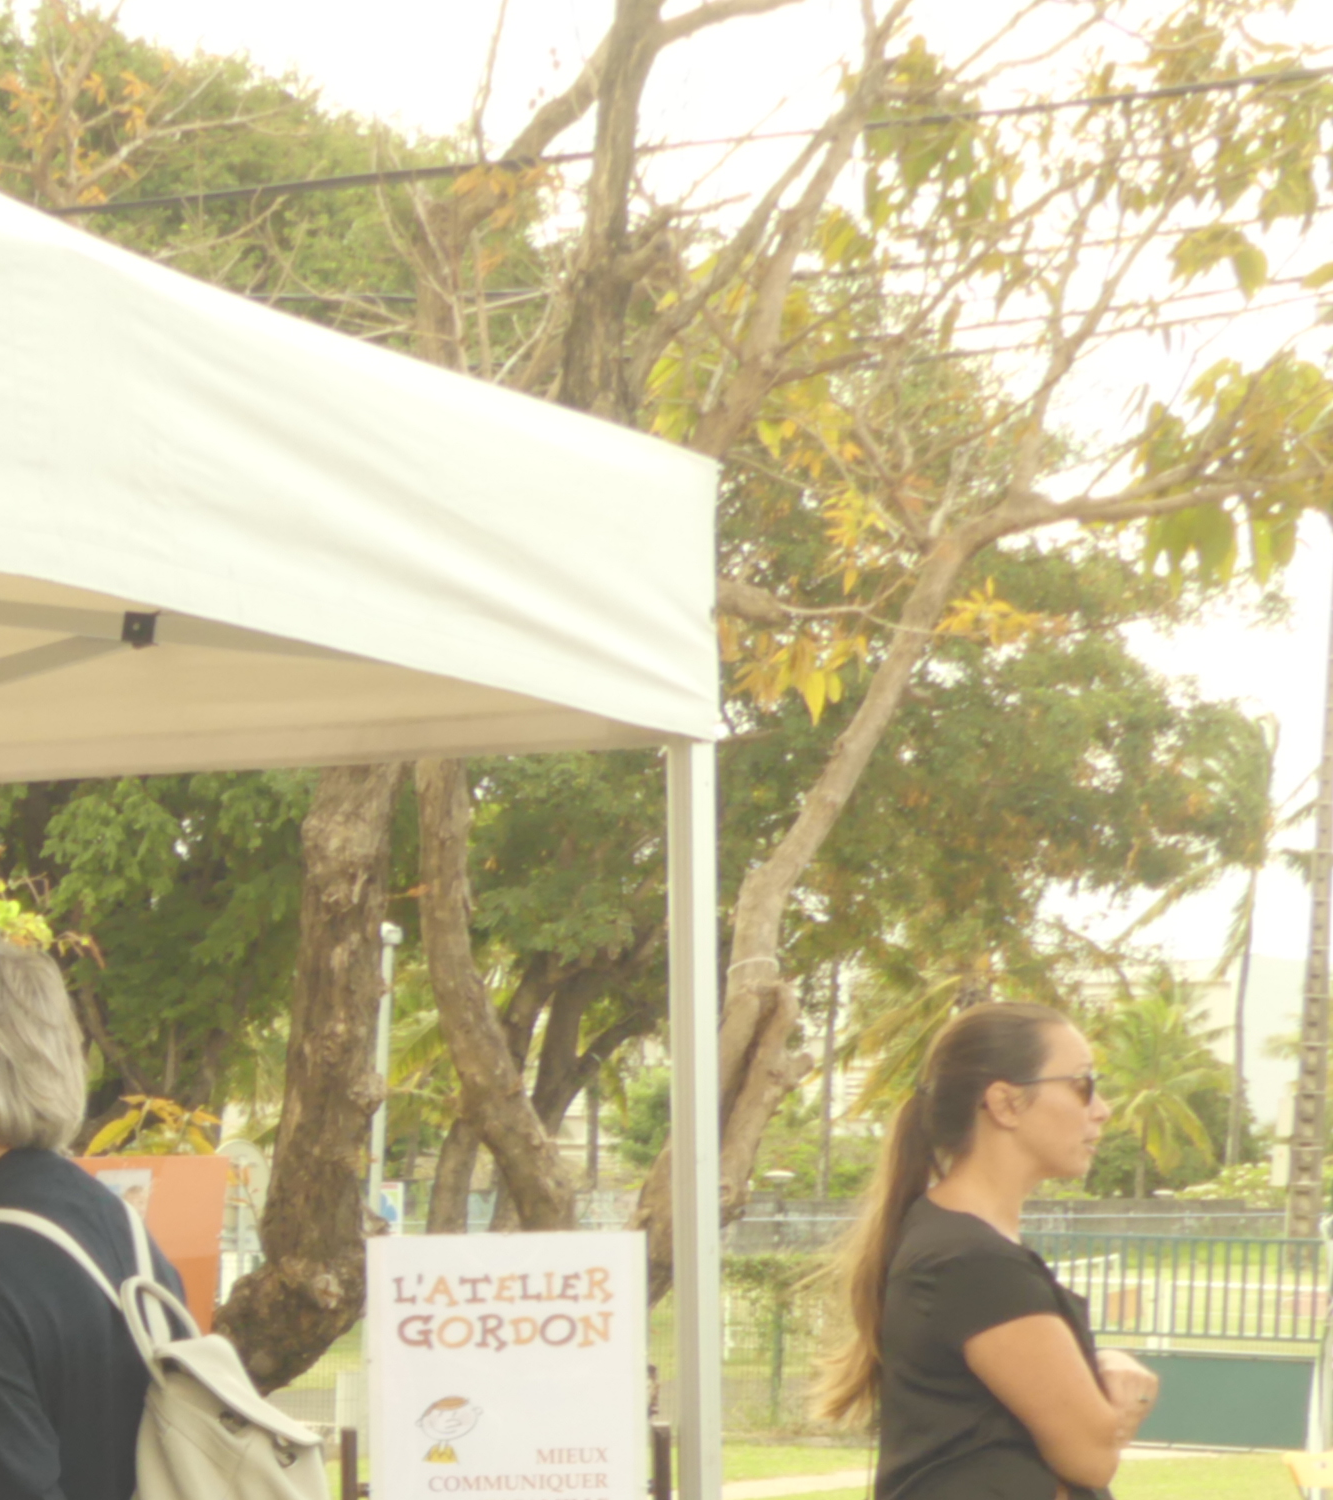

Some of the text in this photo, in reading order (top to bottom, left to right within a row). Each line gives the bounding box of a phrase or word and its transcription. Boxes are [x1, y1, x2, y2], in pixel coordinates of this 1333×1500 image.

[392, 1267, 614, 1308] L'ATELIER
[397, 1312, 614, 1352] GORDON
[536, 1447, 609, 1465] MIEUX
[428, 1473, 609, 1493] COMMUNIQUER
